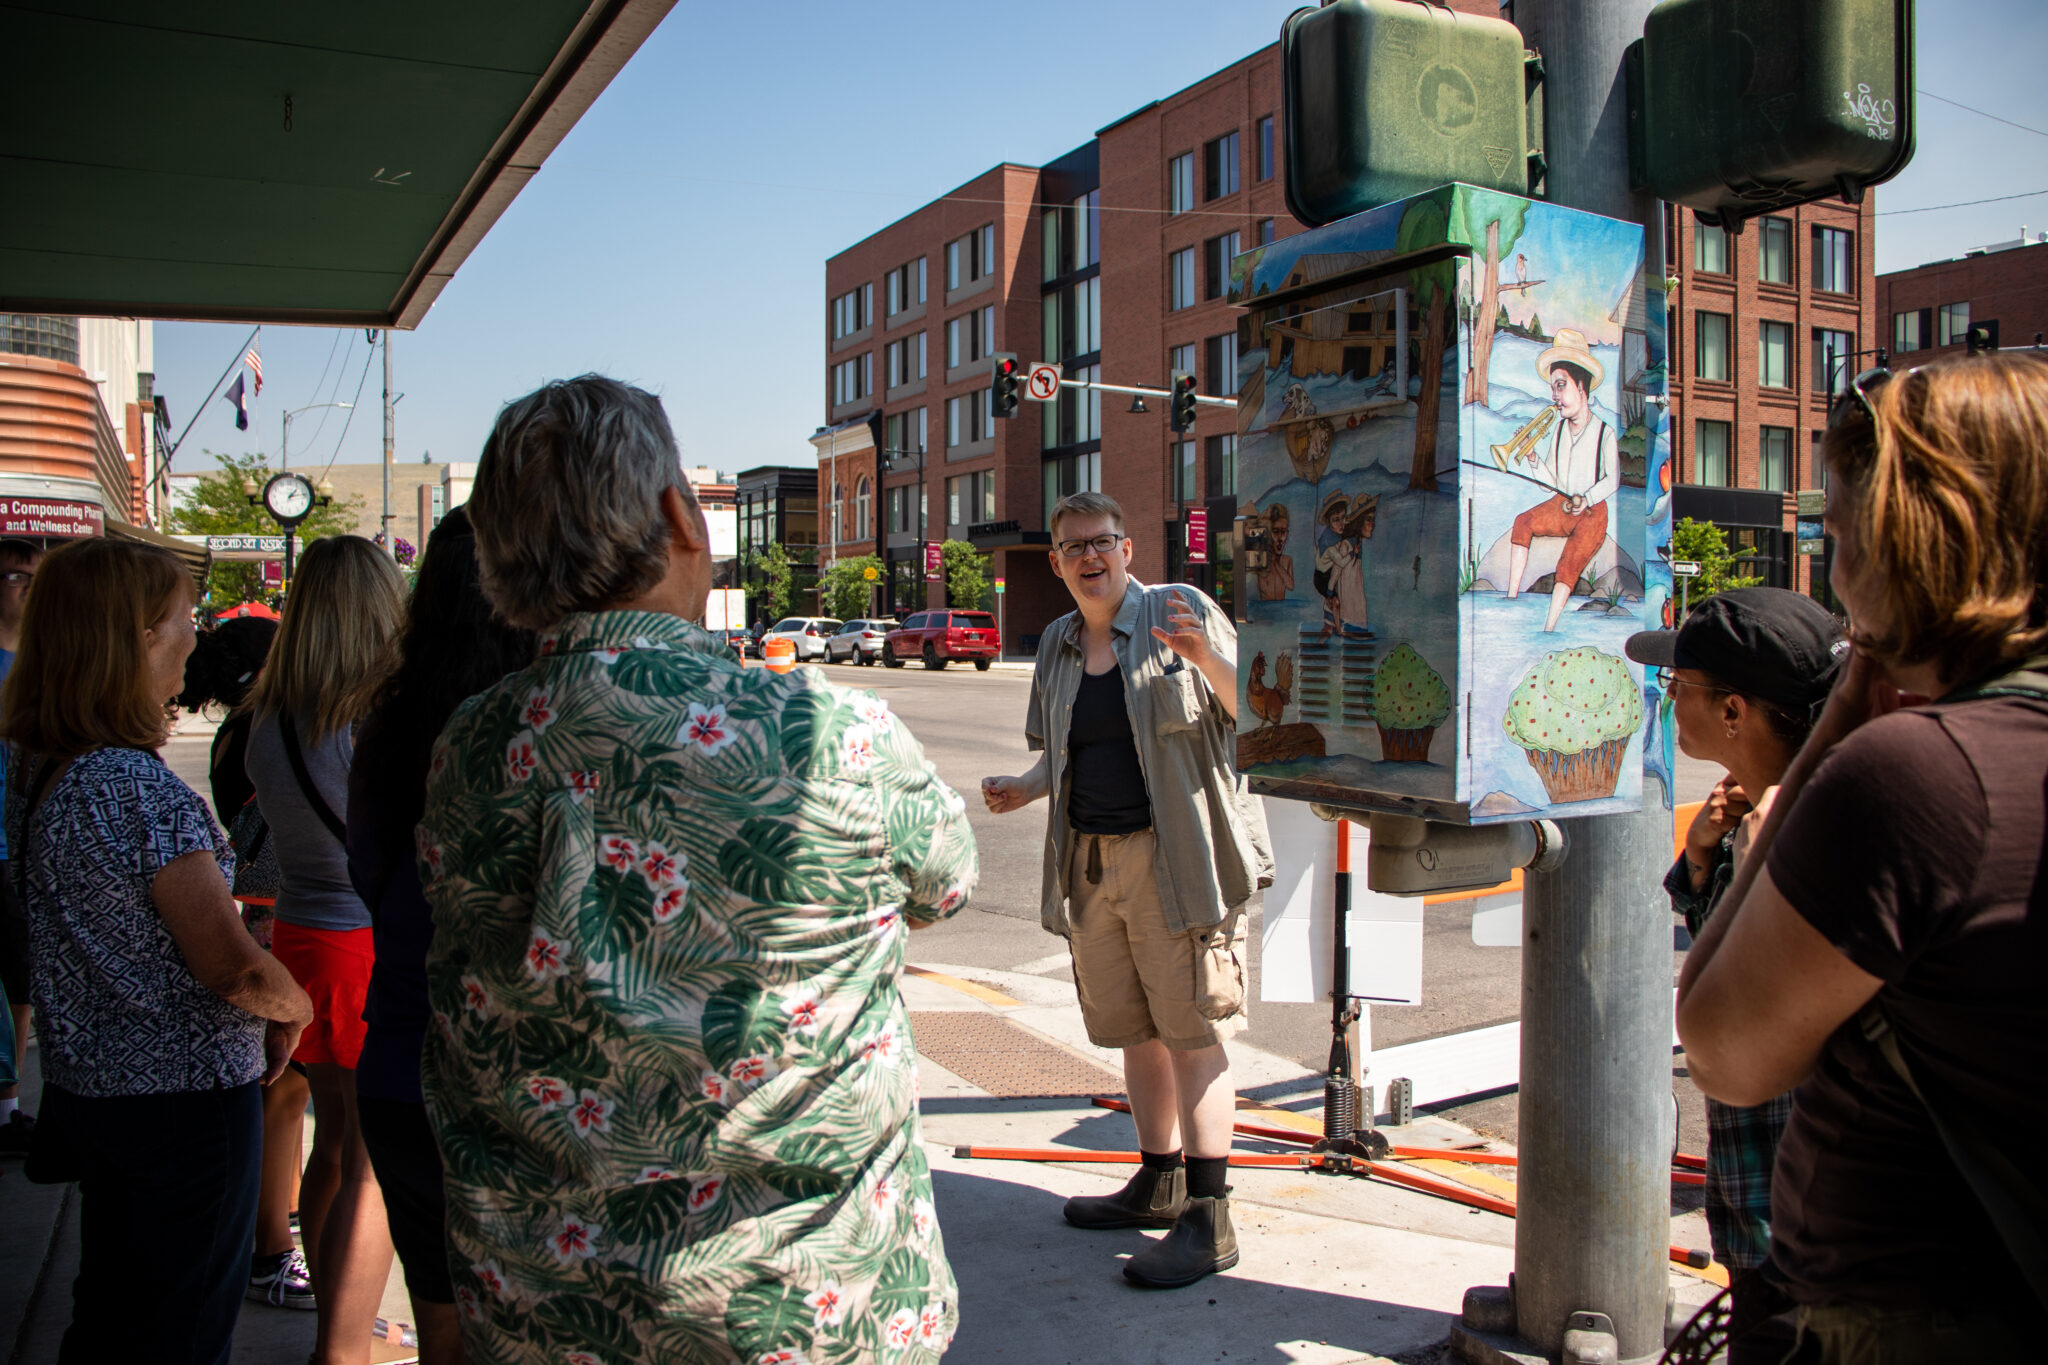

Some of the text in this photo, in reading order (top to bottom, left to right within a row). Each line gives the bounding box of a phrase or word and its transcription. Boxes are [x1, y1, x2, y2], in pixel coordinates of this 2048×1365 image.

[12, 501, 83, 520] Compounding
[6, 520, 93, 534] and Wellness Center
[208, 538, 242, 551] SECOND
[242, 538, 257, 550] SET
